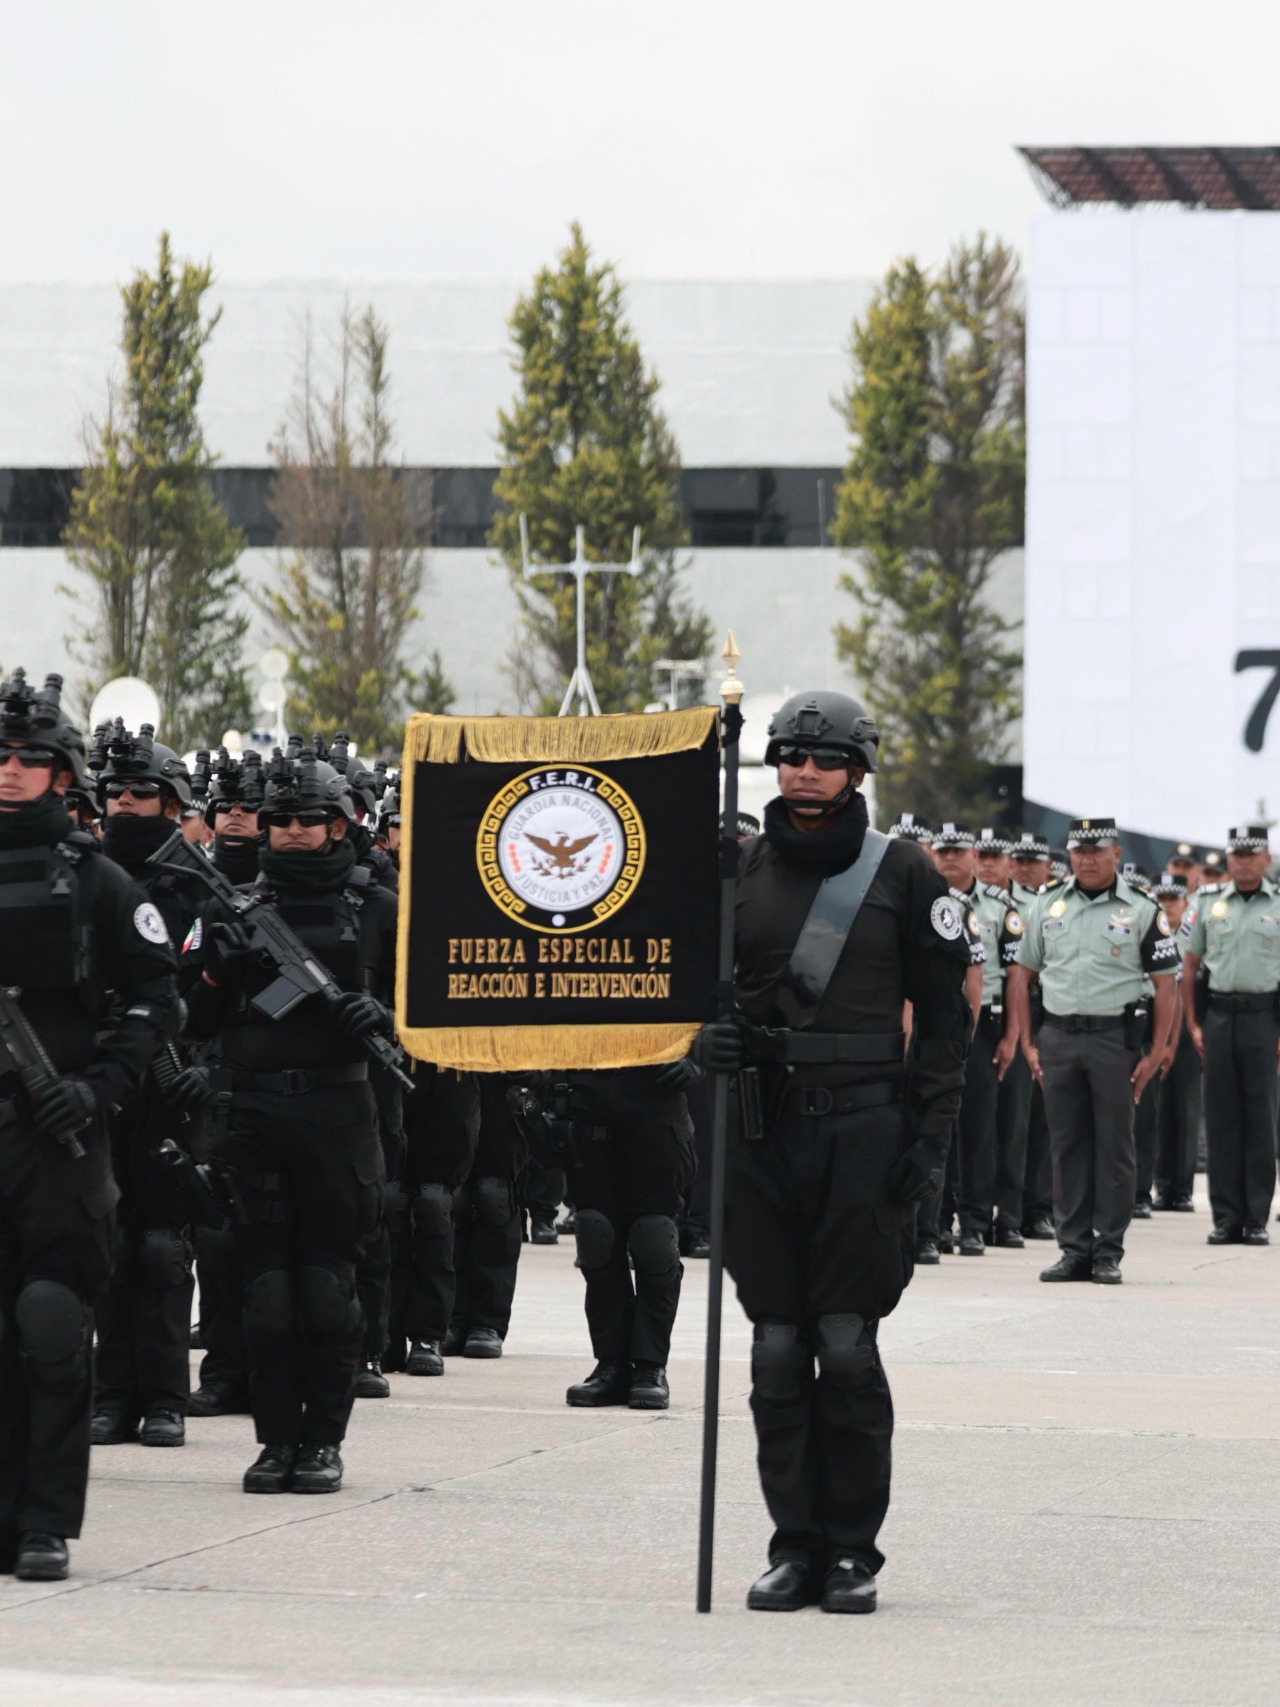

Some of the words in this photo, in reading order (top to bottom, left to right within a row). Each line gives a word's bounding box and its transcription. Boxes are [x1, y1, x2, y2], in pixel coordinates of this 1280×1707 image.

[529, 771, 596, 793] F.E.R.I.
[507, 796, 557, 841] GUARDIA
[561, 794, 615, 842] NACIONAL
[515, 874, 570, 903] JUSTICIA
[571, 888, 581, 900] Y
[583, 873, 604, 897] PAZ
[448, 938, 526, 964] FUERZA
[538, 938, 635, 964] ESPECIAL
[646, 938, 672, 964] DE
[447, 966, 529, 999] REACCIÓN
[534, 973, 546, 998] E
[550, 966, 672, 999] INTERVENCIÓN
